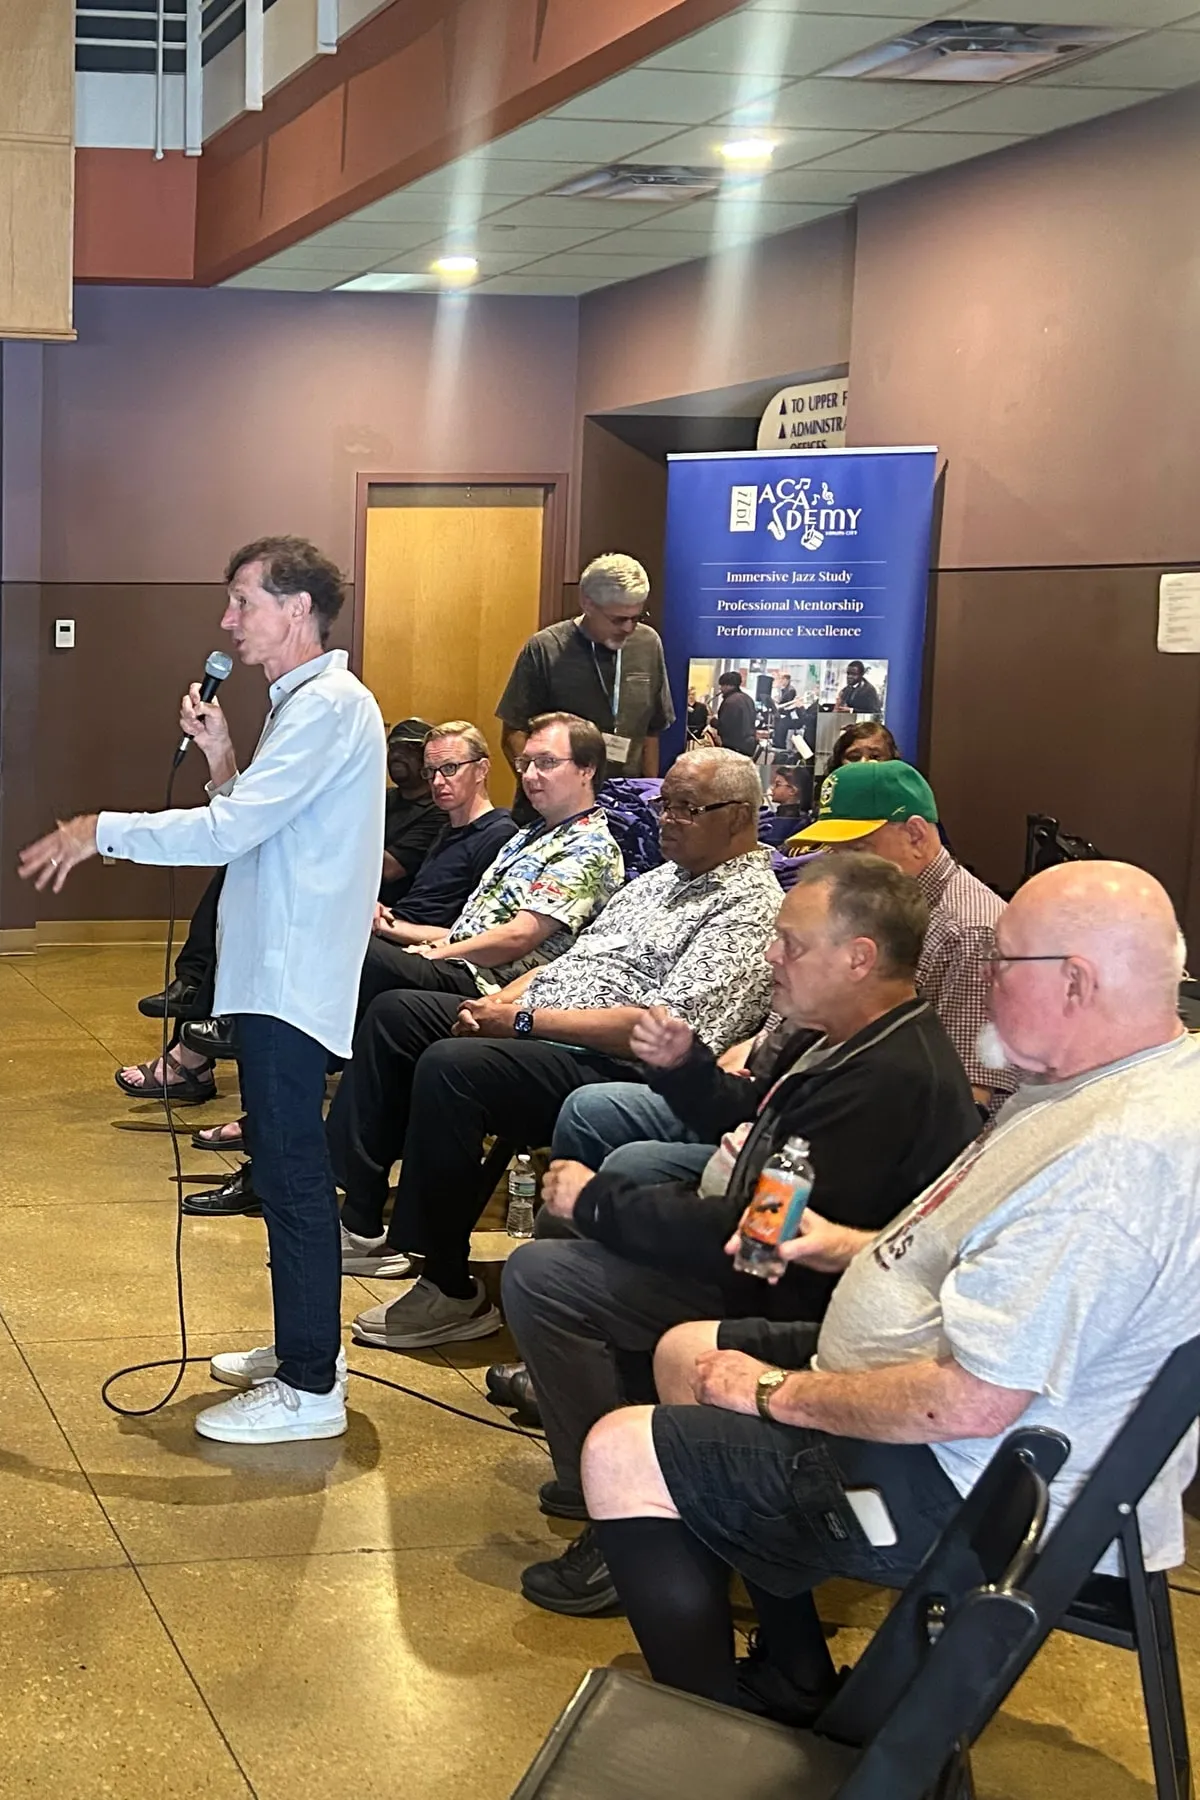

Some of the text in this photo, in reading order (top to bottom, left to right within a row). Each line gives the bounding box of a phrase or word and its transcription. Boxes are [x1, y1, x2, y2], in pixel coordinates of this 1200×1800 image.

[792, 391, 849, 413] TO UPPER F
[726, 570, 853, 584] Immersive Jazz Study
[717, 599, 864, 612] Professional Mentorship
[716, 625, 862, 637] Performance Excellence
